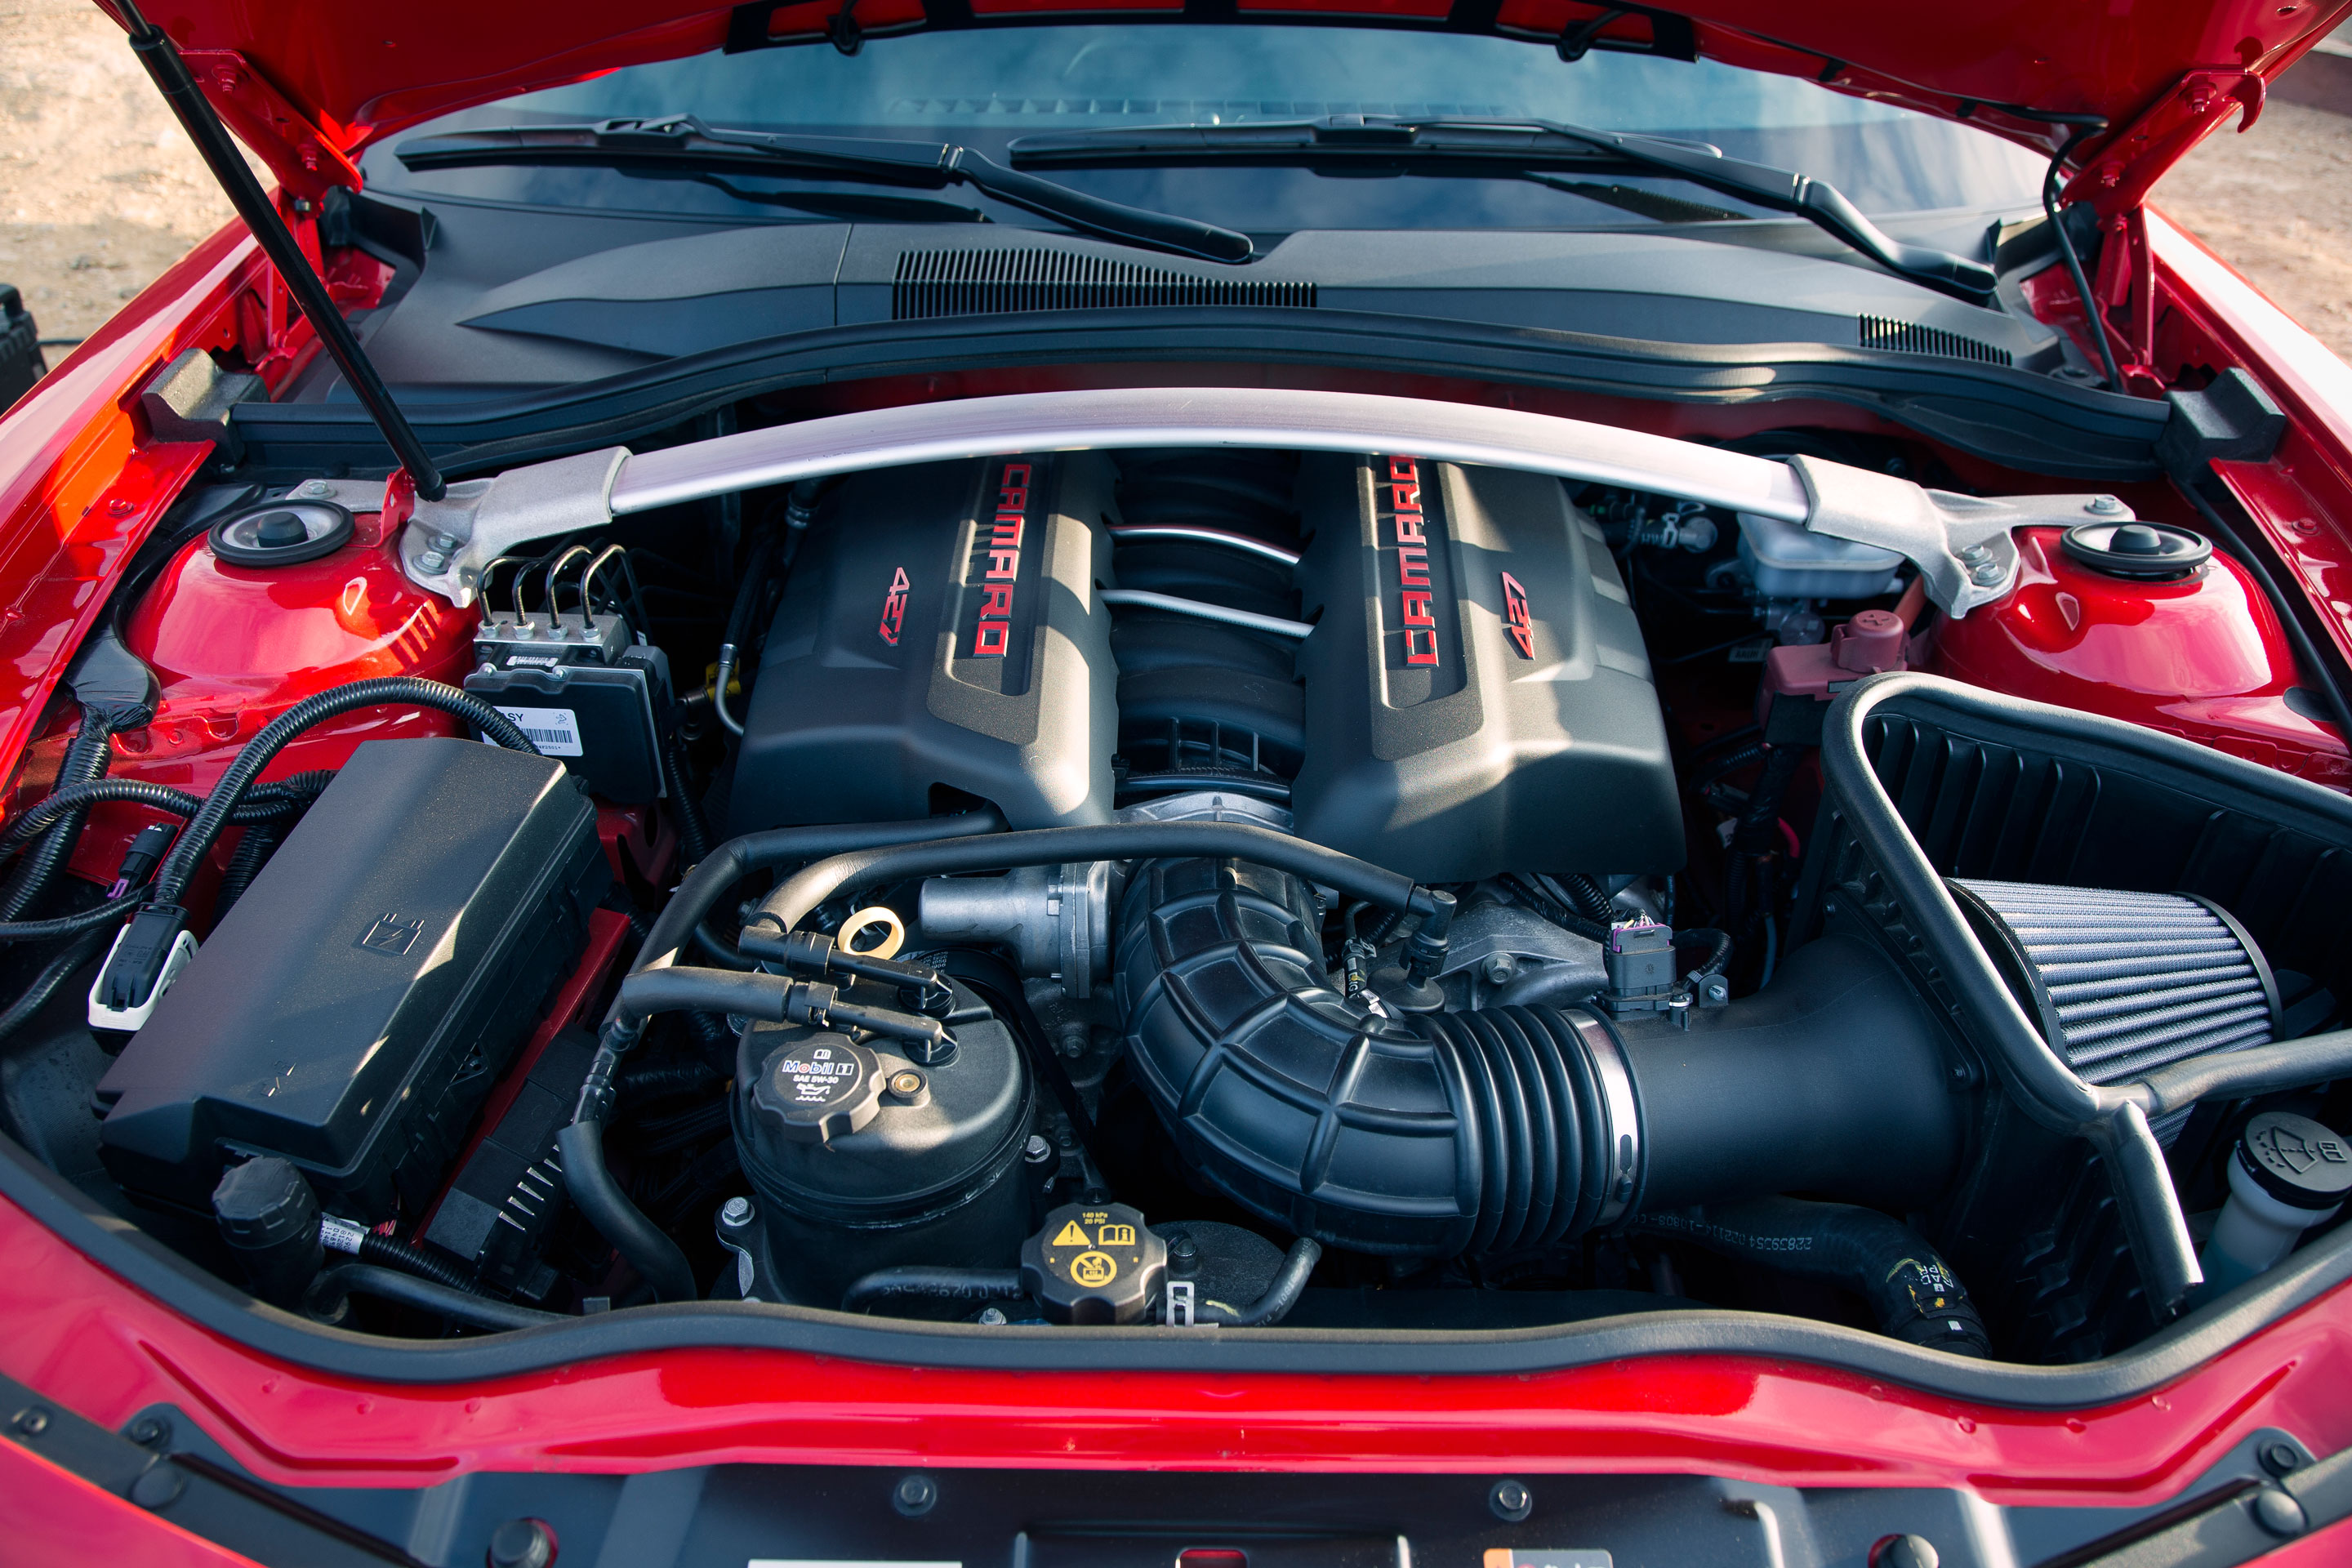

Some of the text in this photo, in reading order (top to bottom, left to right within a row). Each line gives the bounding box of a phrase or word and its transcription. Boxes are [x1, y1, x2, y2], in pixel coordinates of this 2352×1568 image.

[973, 464, 1031, 657] CAMARO
[1389, 456, 1439, 667] CAMARO
[878, 567, 911, 646] 427
[1502, 571, 1536, 661] 427
[782, 1059, 835, 1076] Mobil
[792, 1074, 840, 1085] SAE 5W-30
